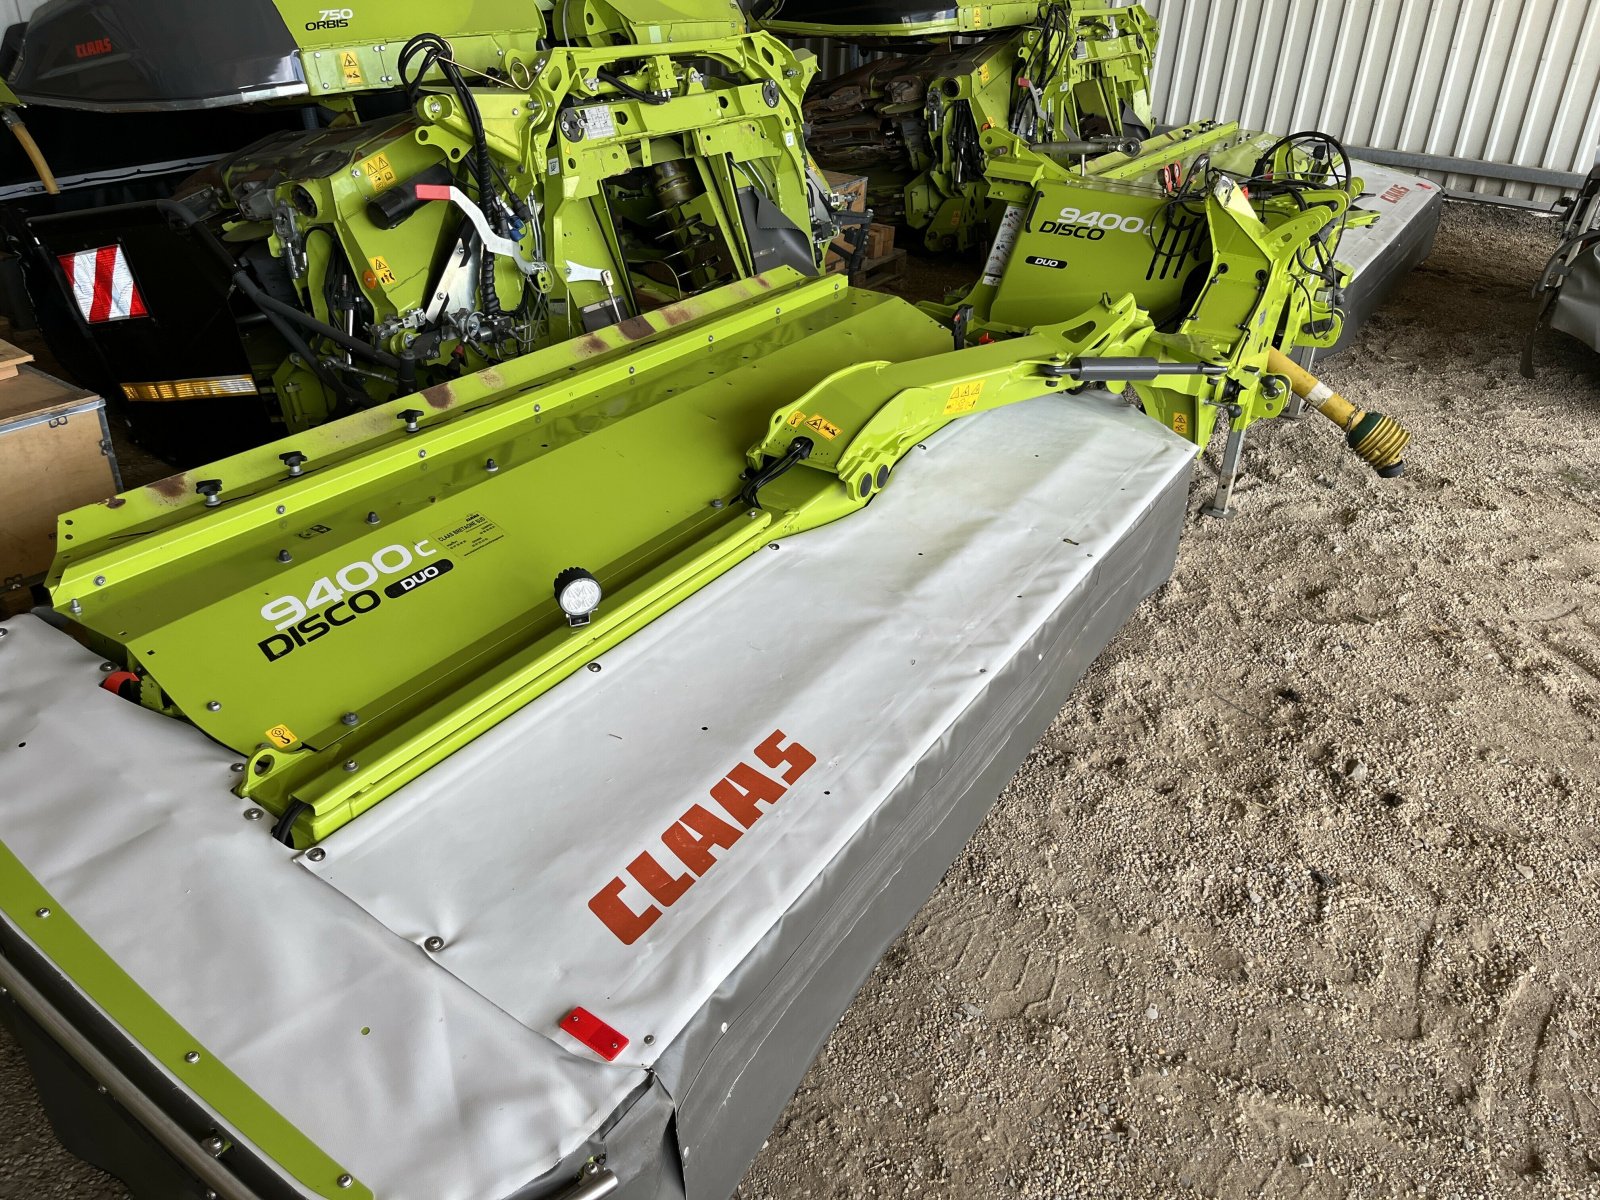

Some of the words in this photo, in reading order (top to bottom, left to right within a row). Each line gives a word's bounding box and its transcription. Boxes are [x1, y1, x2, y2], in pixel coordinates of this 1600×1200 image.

[305, 19, 348, 31] ORBIS
[319, 8, 353, 21] 750
[75, 37, 112, 58] CLAAS
[1039, 220, 1105, 240] DISCO
[1057, 207, 1144, 233] 9400
[1035, 258, 1058, 267] DUO
[260, 544, 413, 632] 9400
[400, 566, 439, 591] DUO
[257, 589, 381, 662] DISCO
[588, 729, 817, 946] CLAAS
